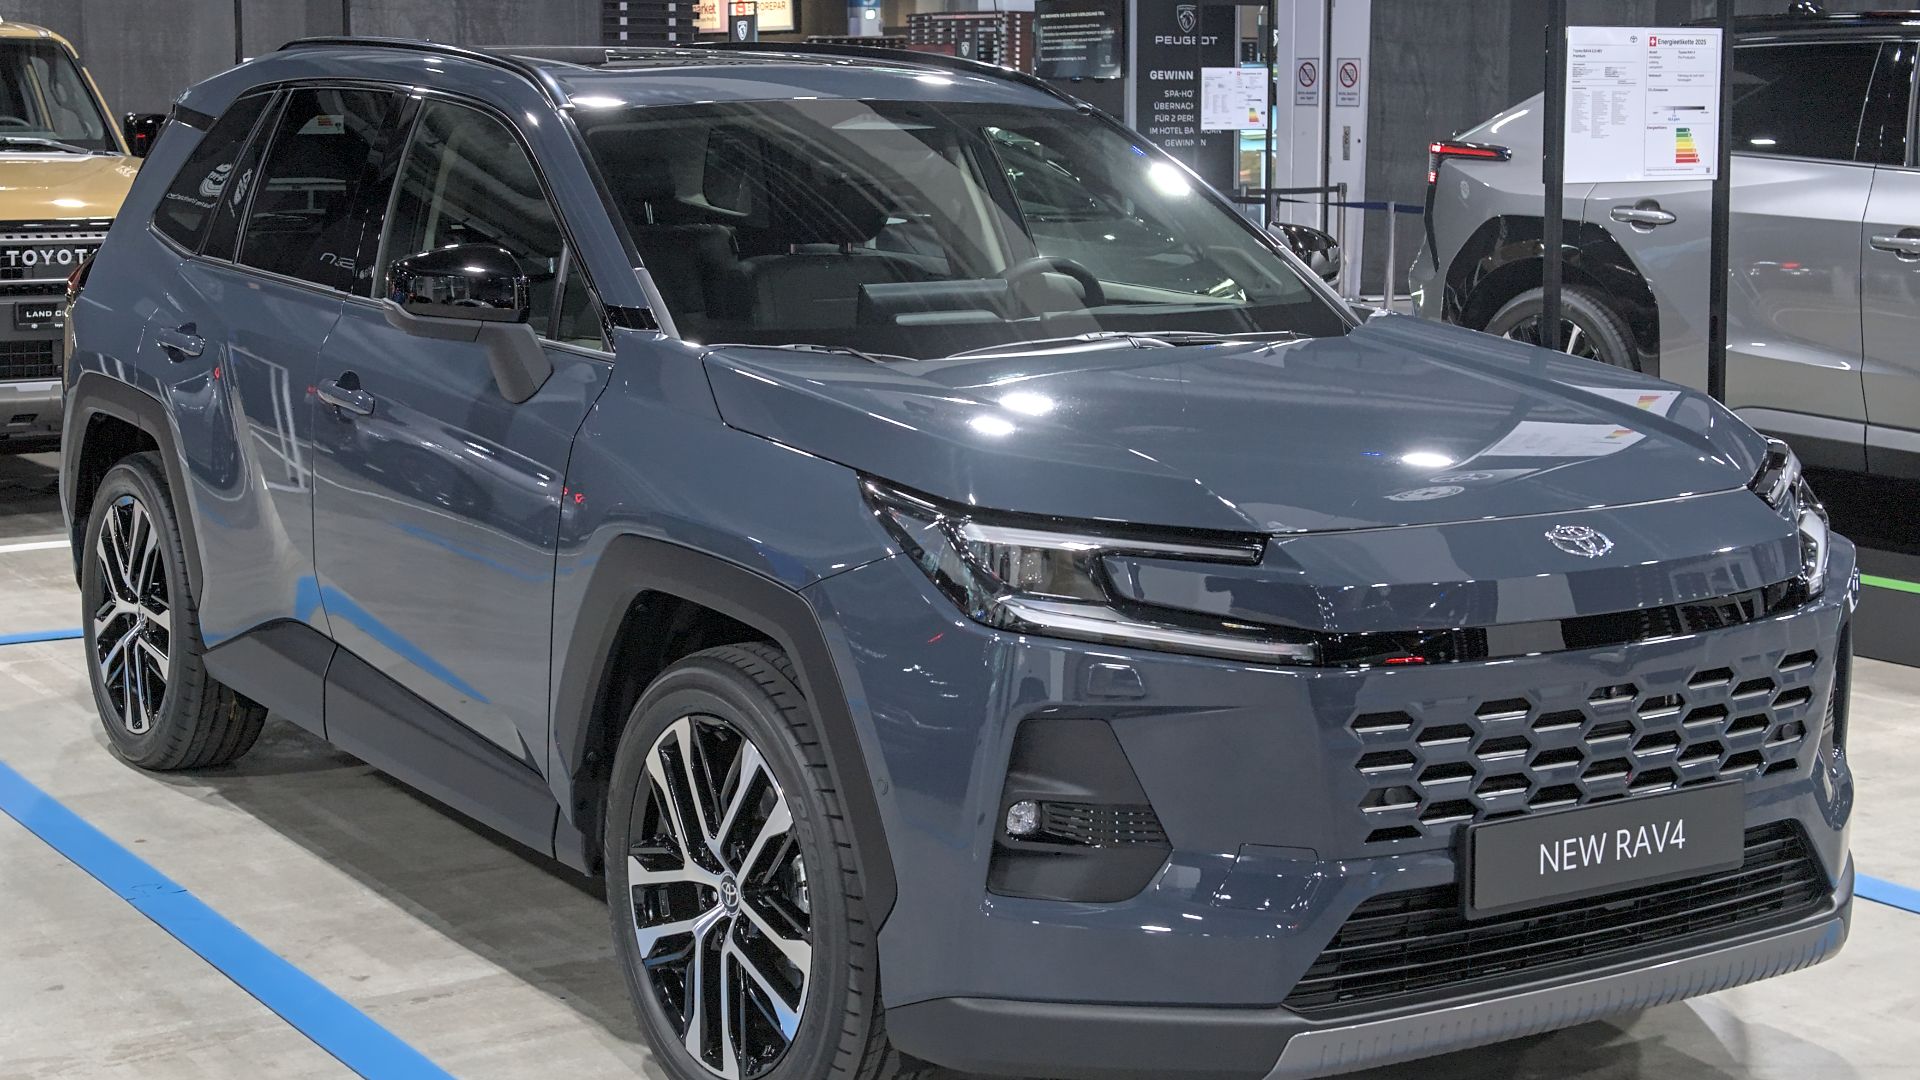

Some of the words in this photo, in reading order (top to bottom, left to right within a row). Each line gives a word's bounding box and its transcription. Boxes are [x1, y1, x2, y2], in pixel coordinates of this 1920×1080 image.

[1657, 38, 1694, 46] Energieetikette
[1695, 38, 1707, 46] 2025
[1149, 70, 1194, 80] GEWINN
[1164, 89, 1195, 98] SPA-HO
[1154, 113, 1170, 122] FÜR
[1149, 127, 1158, 135] IM
[1159, 127, 1183, 135] HOTEL
[1184, 127, 1195, 135] BA
[6, 248, 98, 267] TOYOT
[26, 310, 52, 318] LAND
[55, 309, 64, 317] C
[1540, 832, 1607, 875] NEW
[1616, 818, 1686, 861] RAV4
